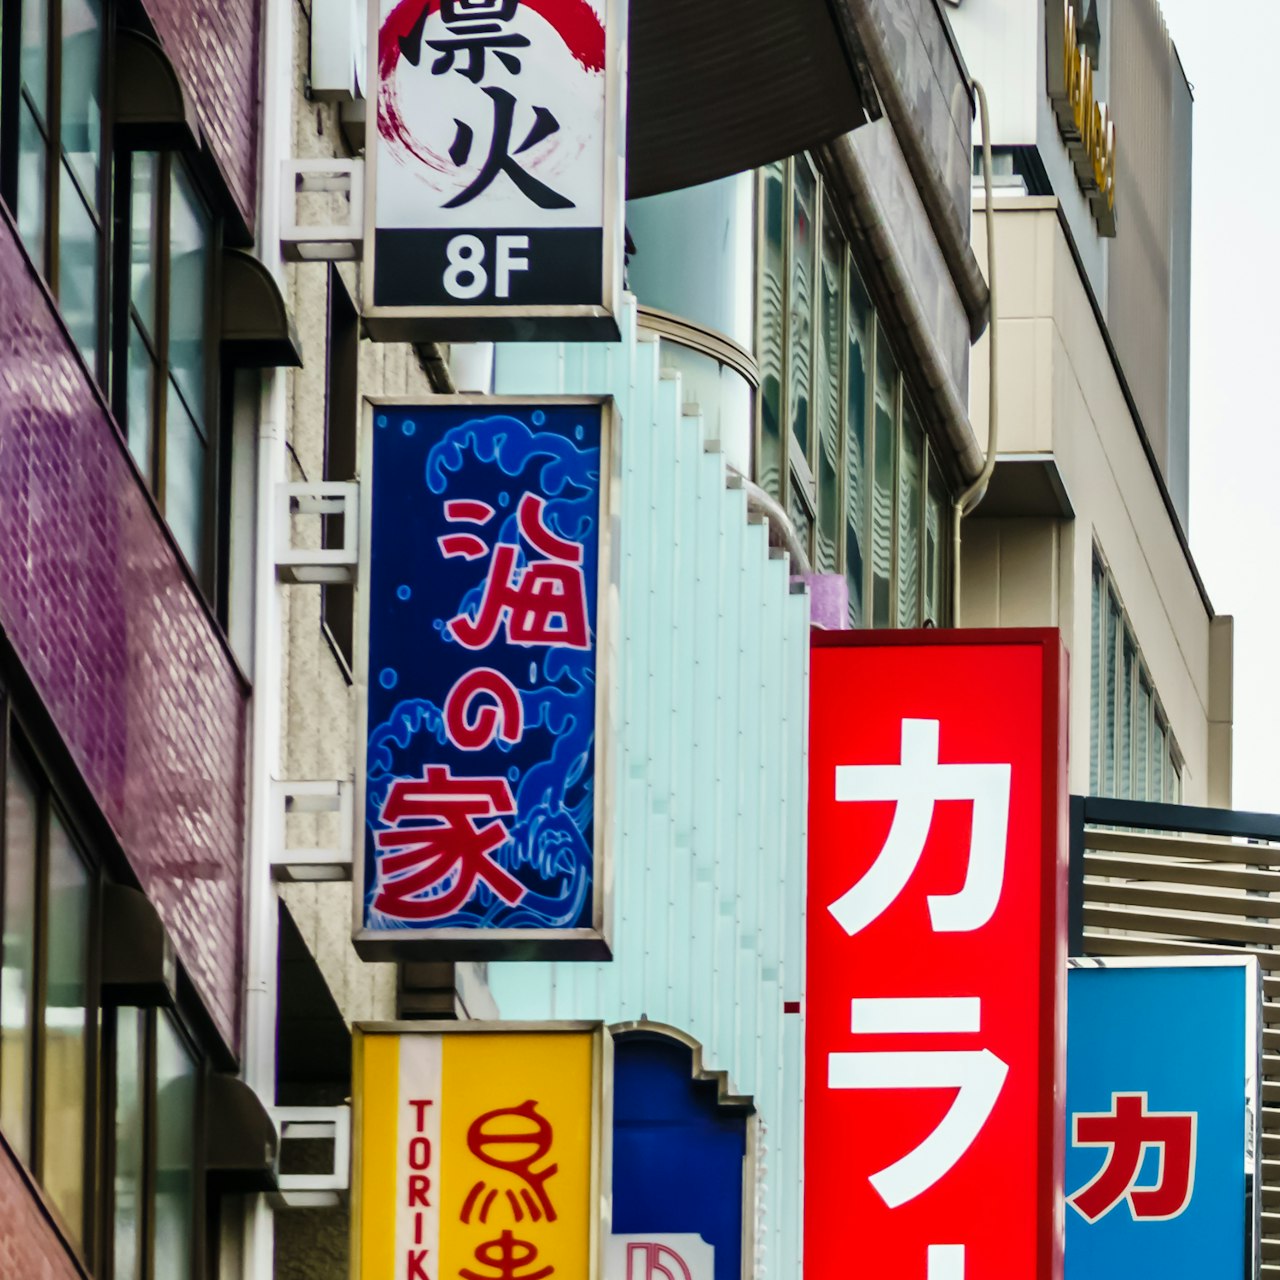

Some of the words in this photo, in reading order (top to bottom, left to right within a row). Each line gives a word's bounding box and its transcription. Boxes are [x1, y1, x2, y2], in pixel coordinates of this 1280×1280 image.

[443, 233, 530, 299] 8F
[371, 491, 591, 921] 海の家
